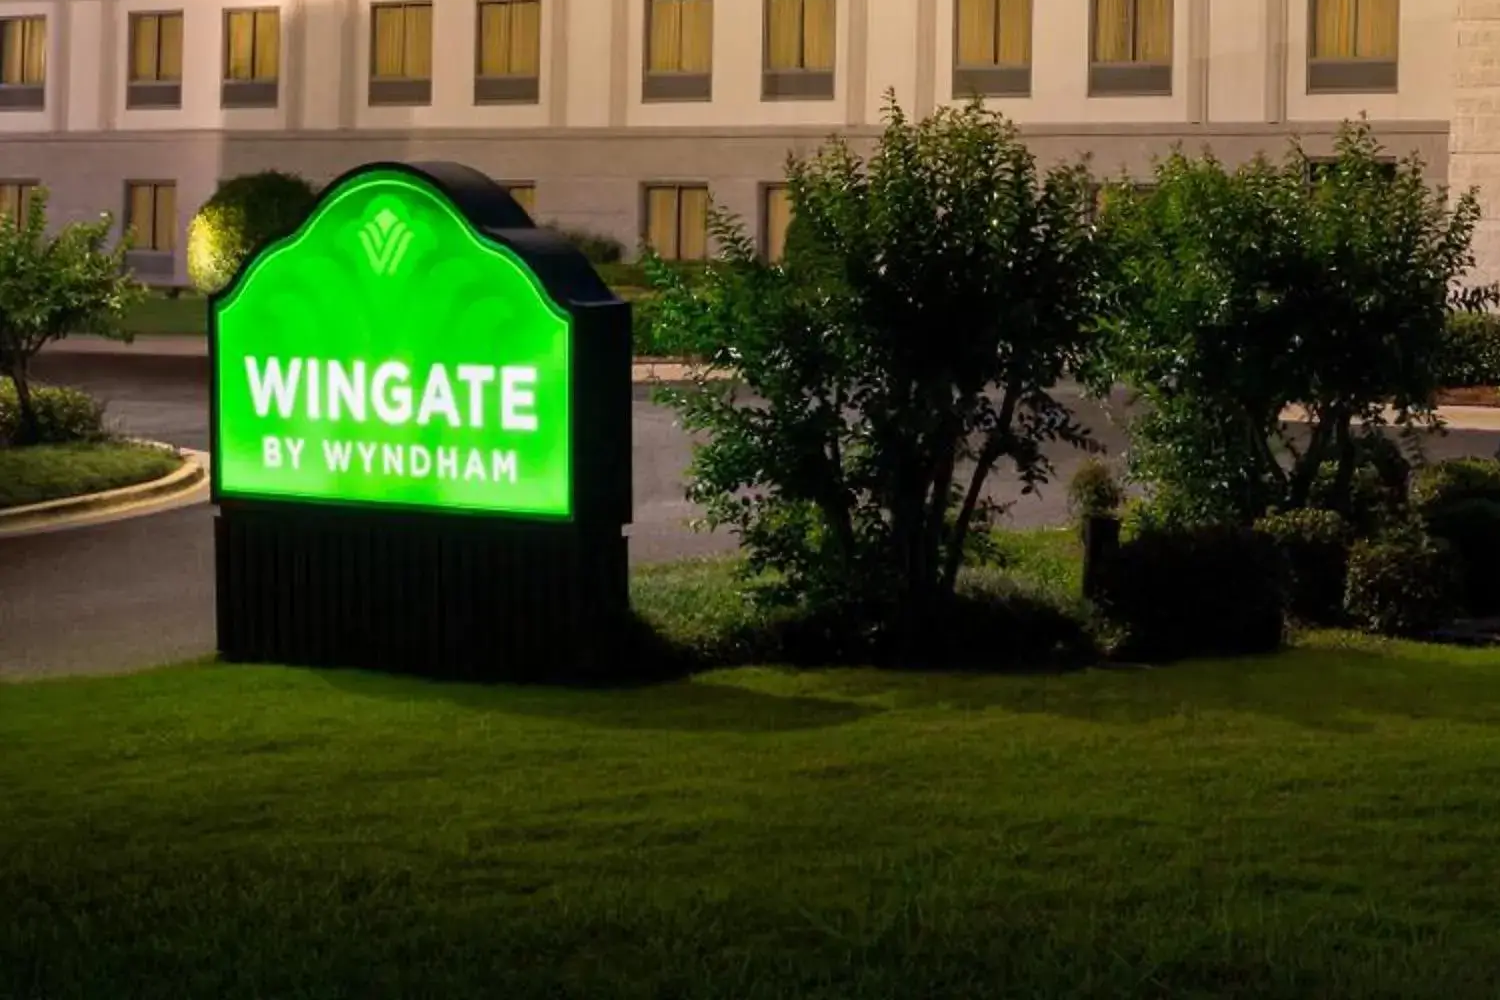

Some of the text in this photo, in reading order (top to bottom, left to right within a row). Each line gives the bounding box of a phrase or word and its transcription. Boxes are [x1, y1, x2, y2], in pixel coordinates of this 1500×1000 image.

[244, 355, 539, 431] WINGATE
[262, 436, 518, 484] BY WYNDHAM
